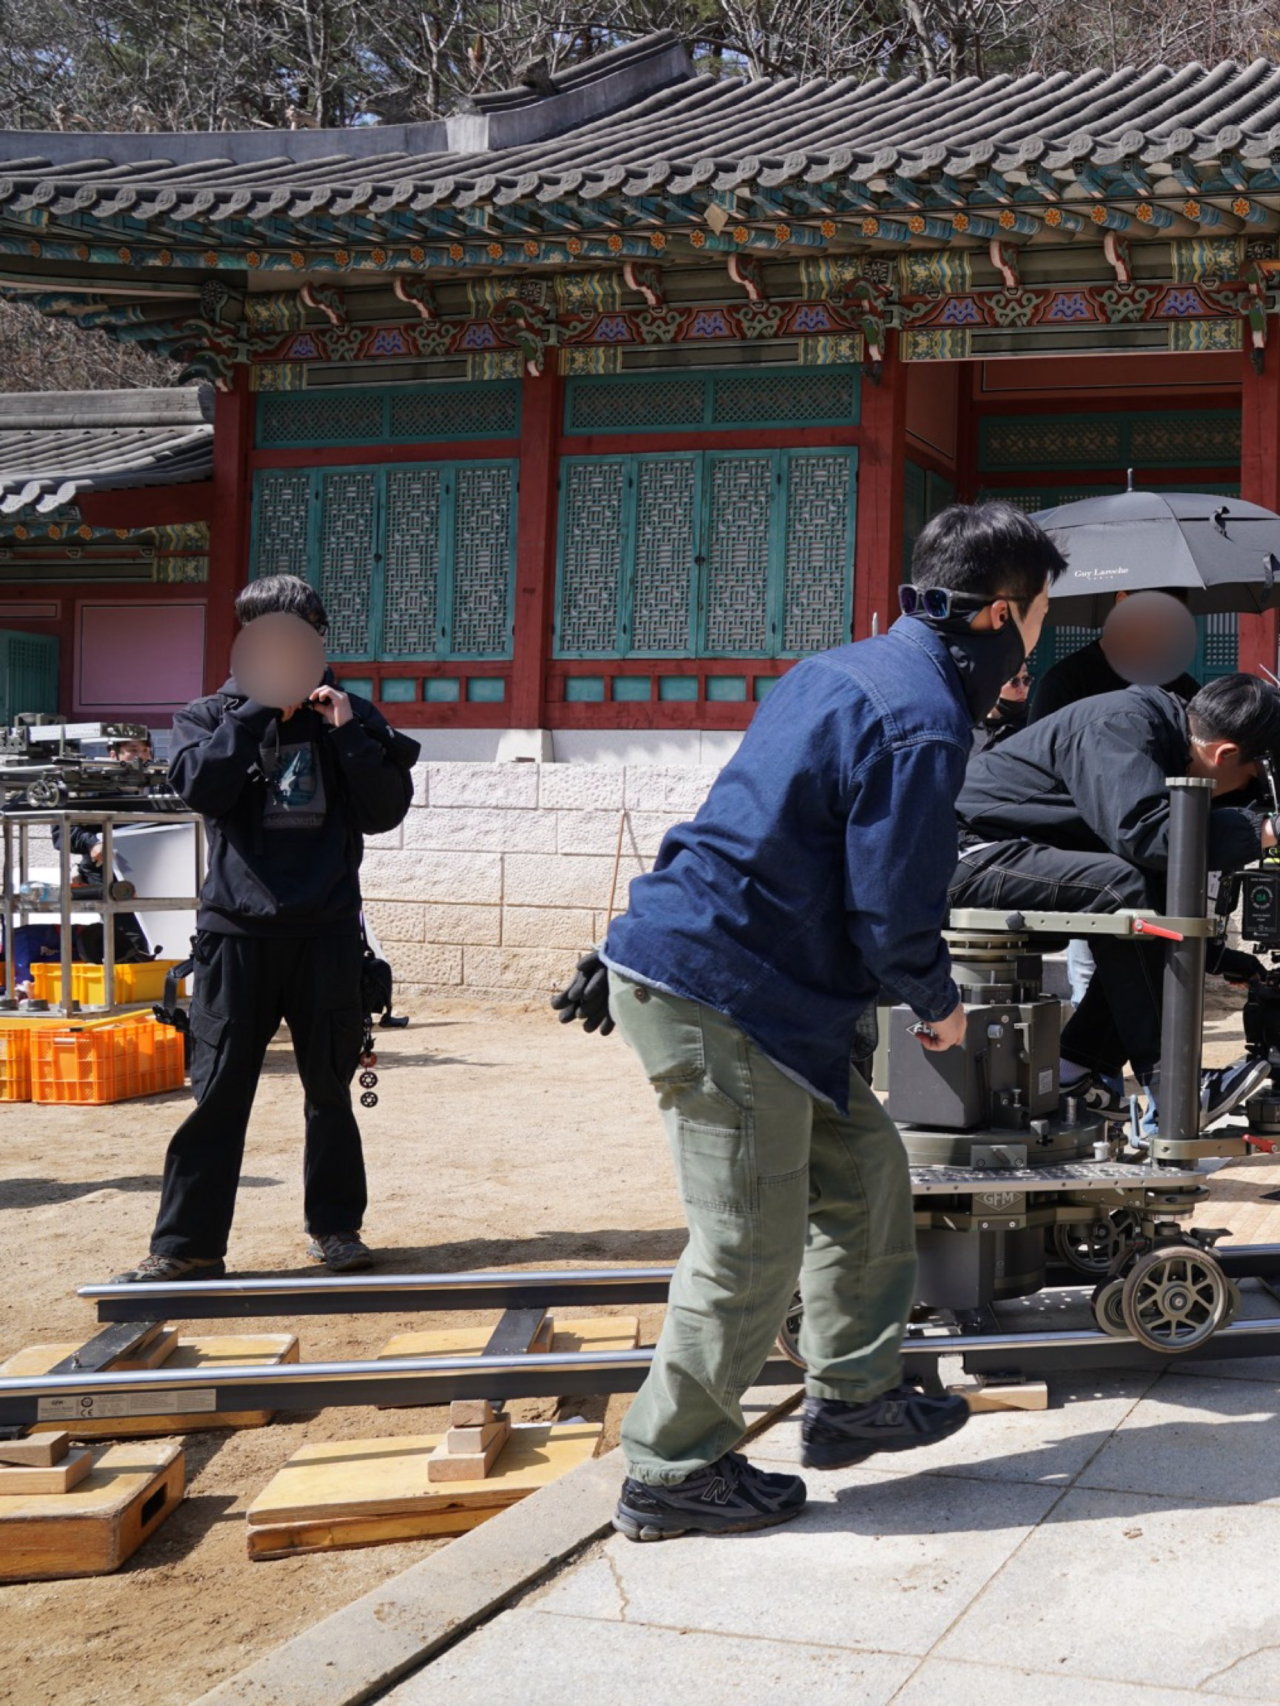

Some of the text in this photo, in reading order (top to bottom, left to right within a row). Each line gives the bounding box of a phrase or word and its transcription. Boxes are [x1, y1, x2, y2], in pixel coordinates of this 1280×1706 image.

[1074, 567, 1128, 579] Guy Laroche
[983, 1191, 1014, 1206] GFM
